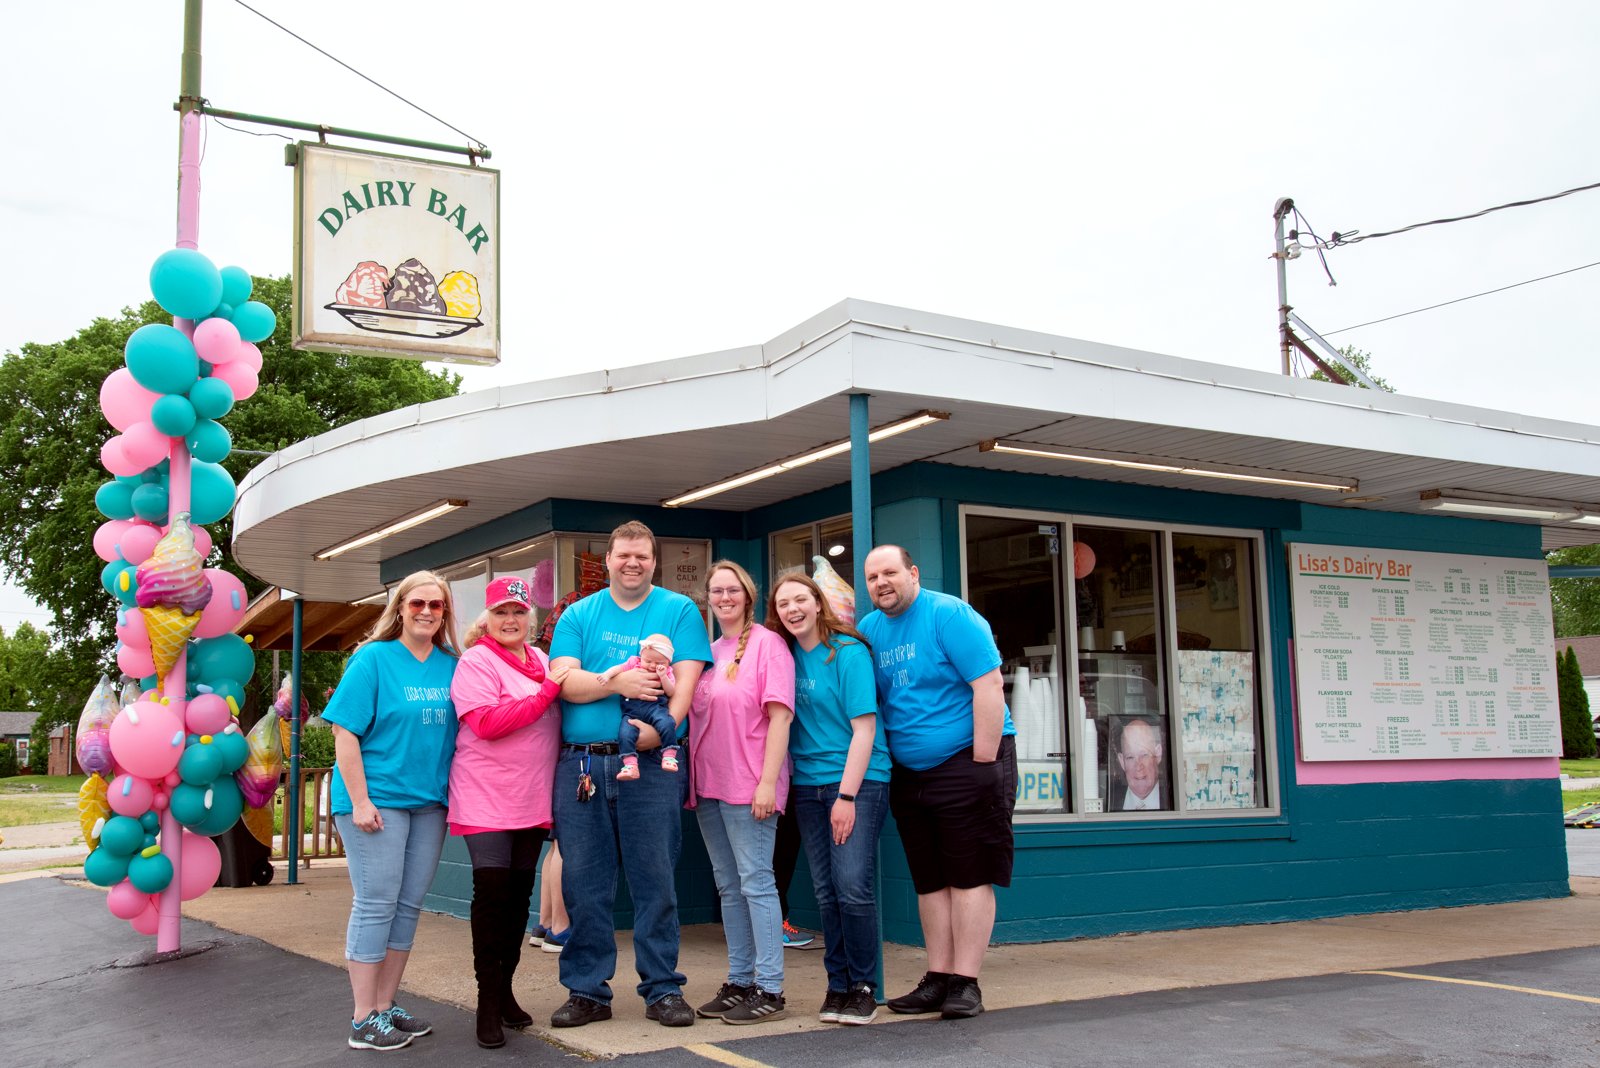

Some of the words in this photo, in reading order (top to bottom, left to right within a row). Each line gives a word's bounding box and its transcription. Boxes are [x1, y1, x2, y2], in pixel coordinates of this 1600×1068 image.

[317, 180, 416, 238] DAIRY
[426, 187, 489, 255] BAR
[676, 564, 697, 573] KEEP
[1299, 553, 1340, 573] Lisa's
[1343, 557, 1383, 580] Dairy
[1387, 559, 1412, 577] Bar
[676, 574, 698, 582] CALM
[403, 686, 425, 701] LISA'S
[434, 708, 447, 725] 1982
